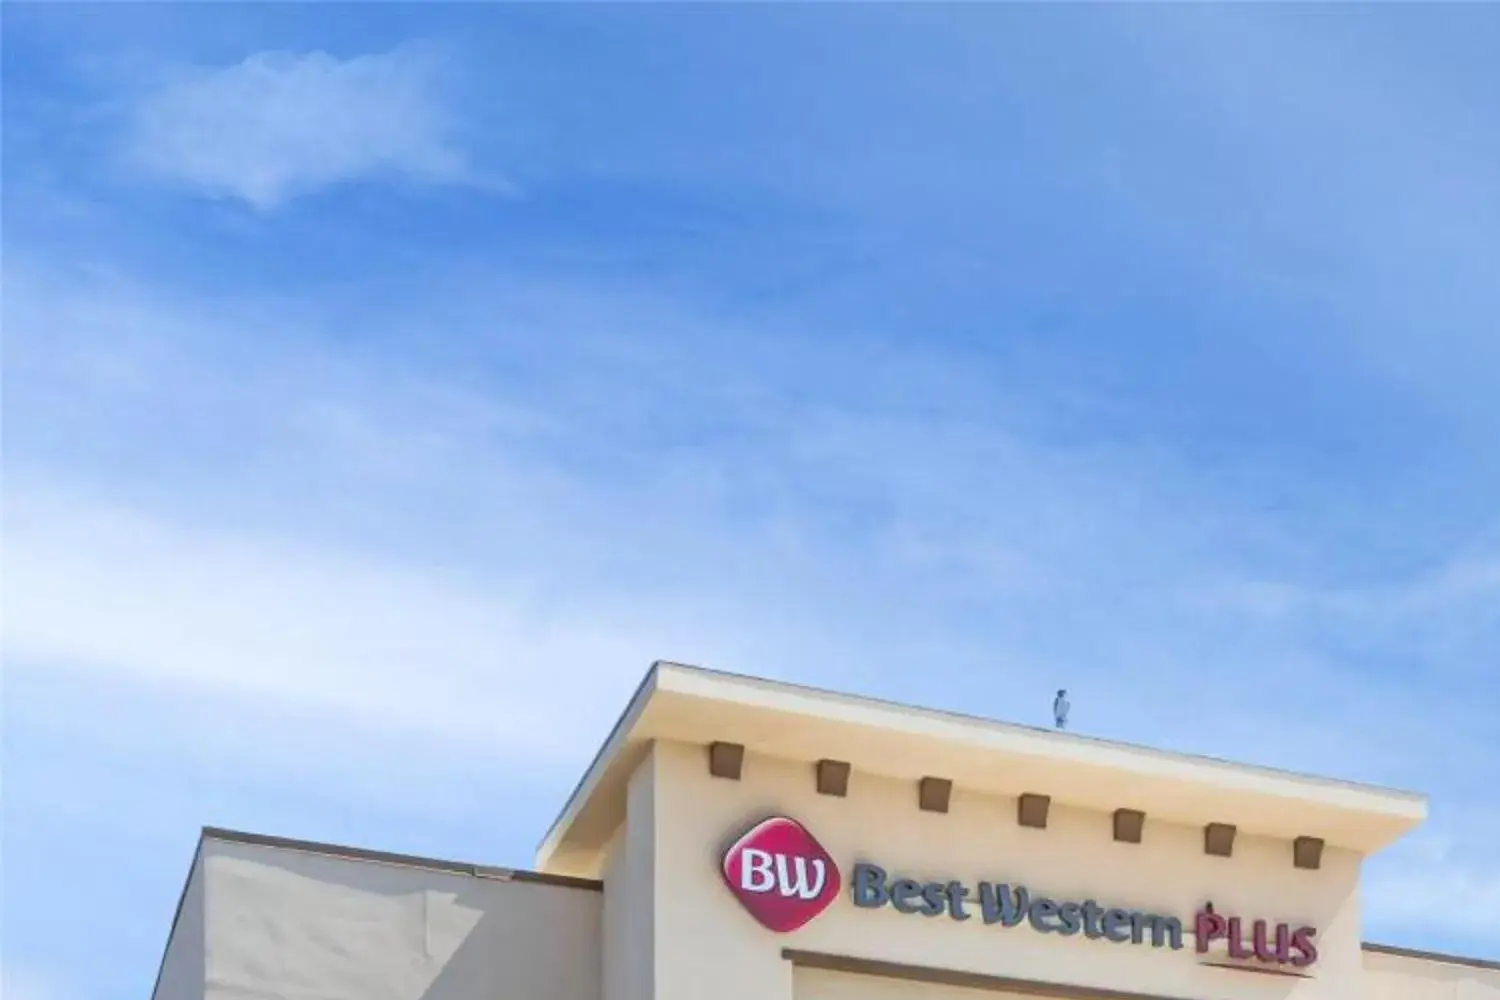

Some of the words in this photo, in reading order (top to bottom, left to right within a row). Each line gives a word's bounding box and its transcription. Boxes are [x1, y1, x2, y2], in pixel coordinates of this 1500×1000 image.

[740, 848, 826, 899] BW
[852, 863, 970, 920] Best
[978, 881, 1183, 950] Western
[1194, 906, 1318, 967] PLUS
